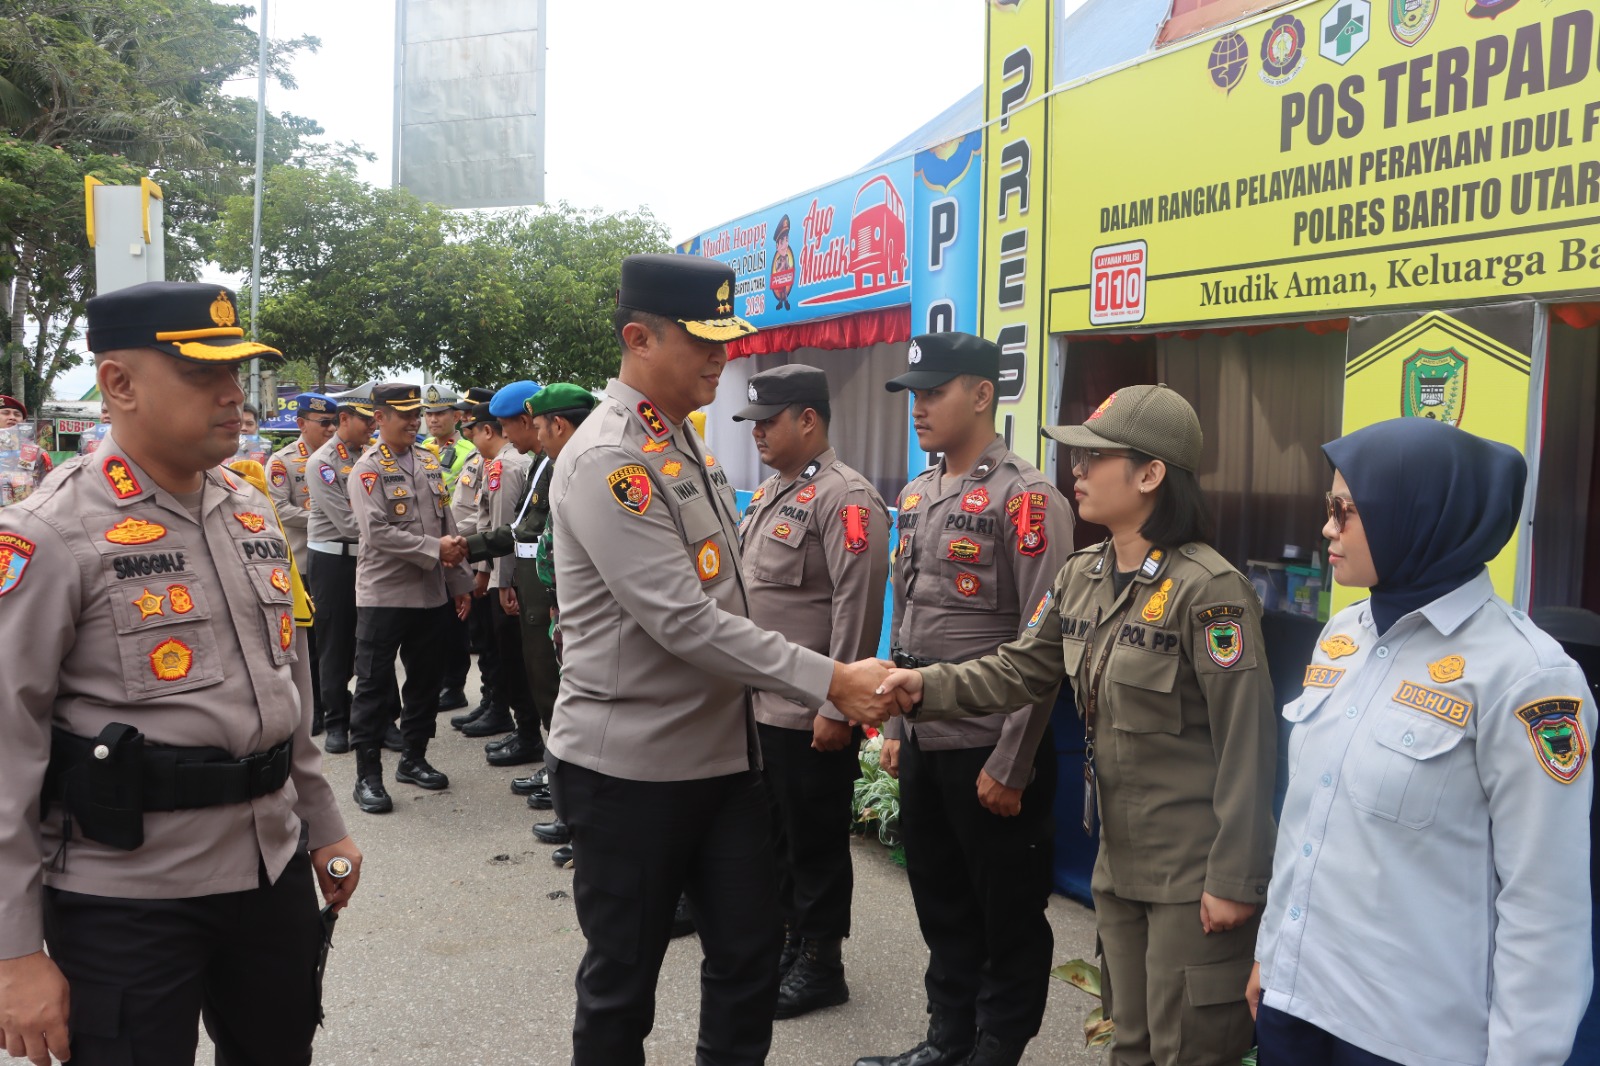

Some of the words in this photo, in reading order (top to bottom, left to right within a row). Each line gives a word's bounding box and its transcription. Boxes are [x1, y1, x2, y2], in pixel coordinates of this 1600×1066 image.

[1280, 75, 1365, 153] POS
[1378, 9, 1600, 129] TERPAD
[1100, 197, 1154, 233] DALAM
[1157, 181, 1231, 223] RANGKA
[1236, 155, 1353, 208] PELAYANAN
[1359, 125, 1493, 185] PERAYAAN
[1501, 108, 1573, 159] IDUL
[803, 198, 835, 250] Ayo
[1293, 198, 1385, 246] POLRES
[1392, 177, 1502, 233] BARITO
[702, 230, 731, 258] Mudik
[733, 222, 767, 252] Happy
[742, 250, 766, 275] POLISI
[798, 235, 852, 288] Mudik
[1097, 255, 1122, 267] LAYANAN
[1122, 252, 1140, 264] POLISI
[1097, 271, 1140, 308] 110
[1199, 272, 1278, 307] Mudik
[1284, 269, 1377, 299] Aman,
[1386, 251, 1547, 289] Keluarga
[672, 481, 699, 500] IWAN
[779, 505, 809, 523] POLRI
[945, 513, 994, 534] POLRI
[1119, 623, 1146, 650] POL
[1151, 632, 1178, 650] PP
[1399, 684, 1467, 721] DISHUB
